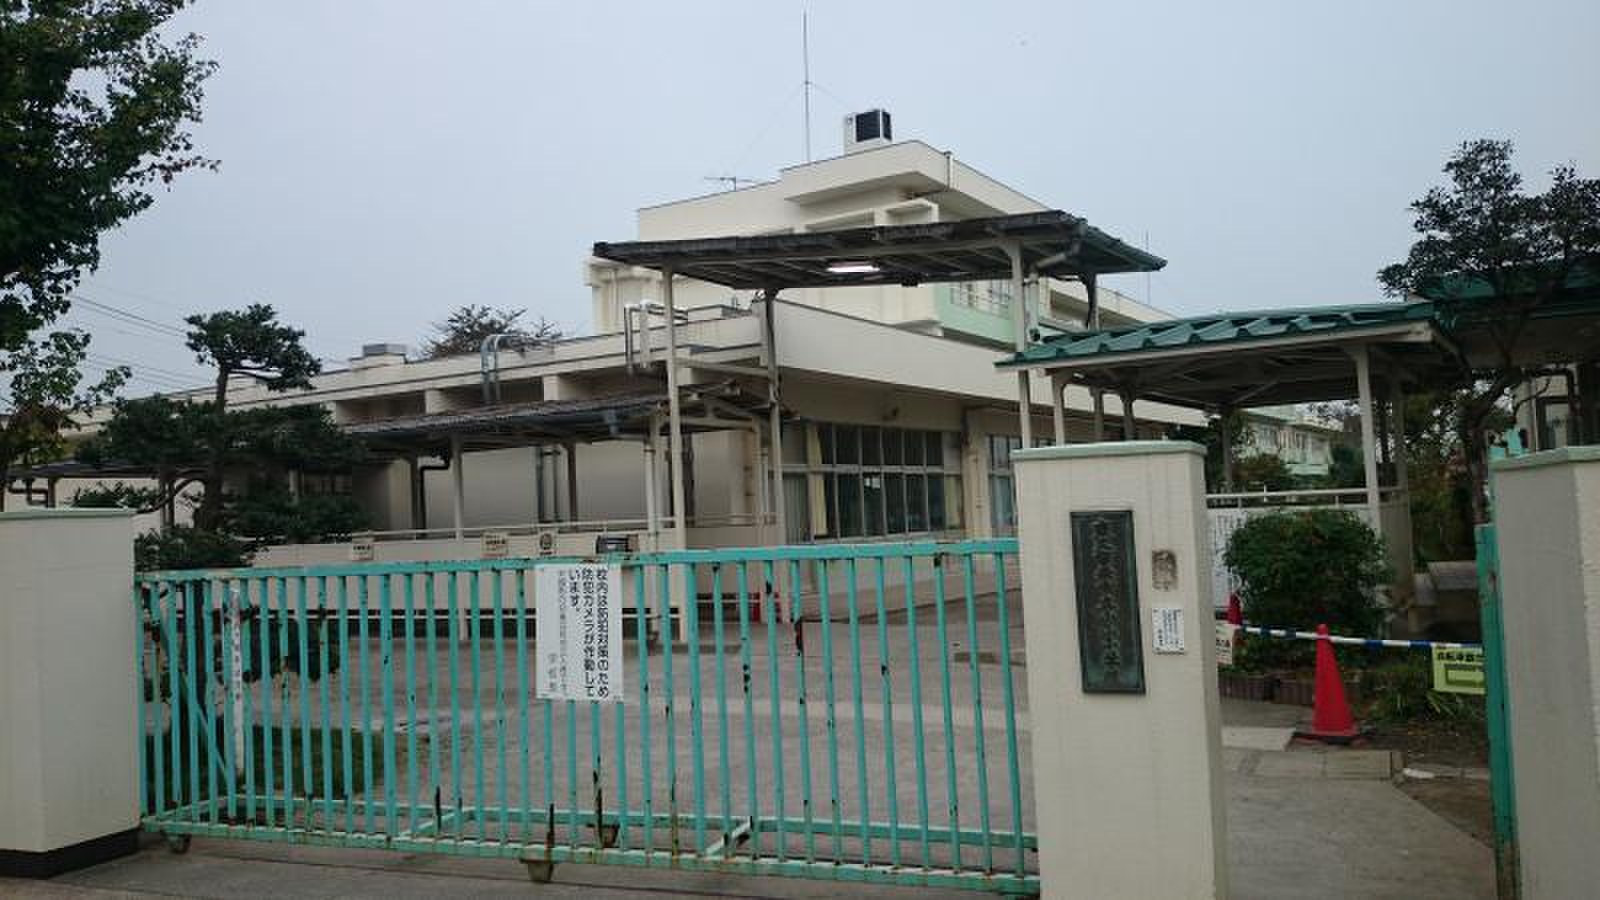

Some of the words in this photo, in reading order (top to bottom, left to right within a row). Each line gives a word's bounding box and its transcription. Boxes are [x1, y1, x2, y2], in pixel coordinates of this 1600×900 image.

[582, 567, 595, 697] 防犯カメラが作動して
